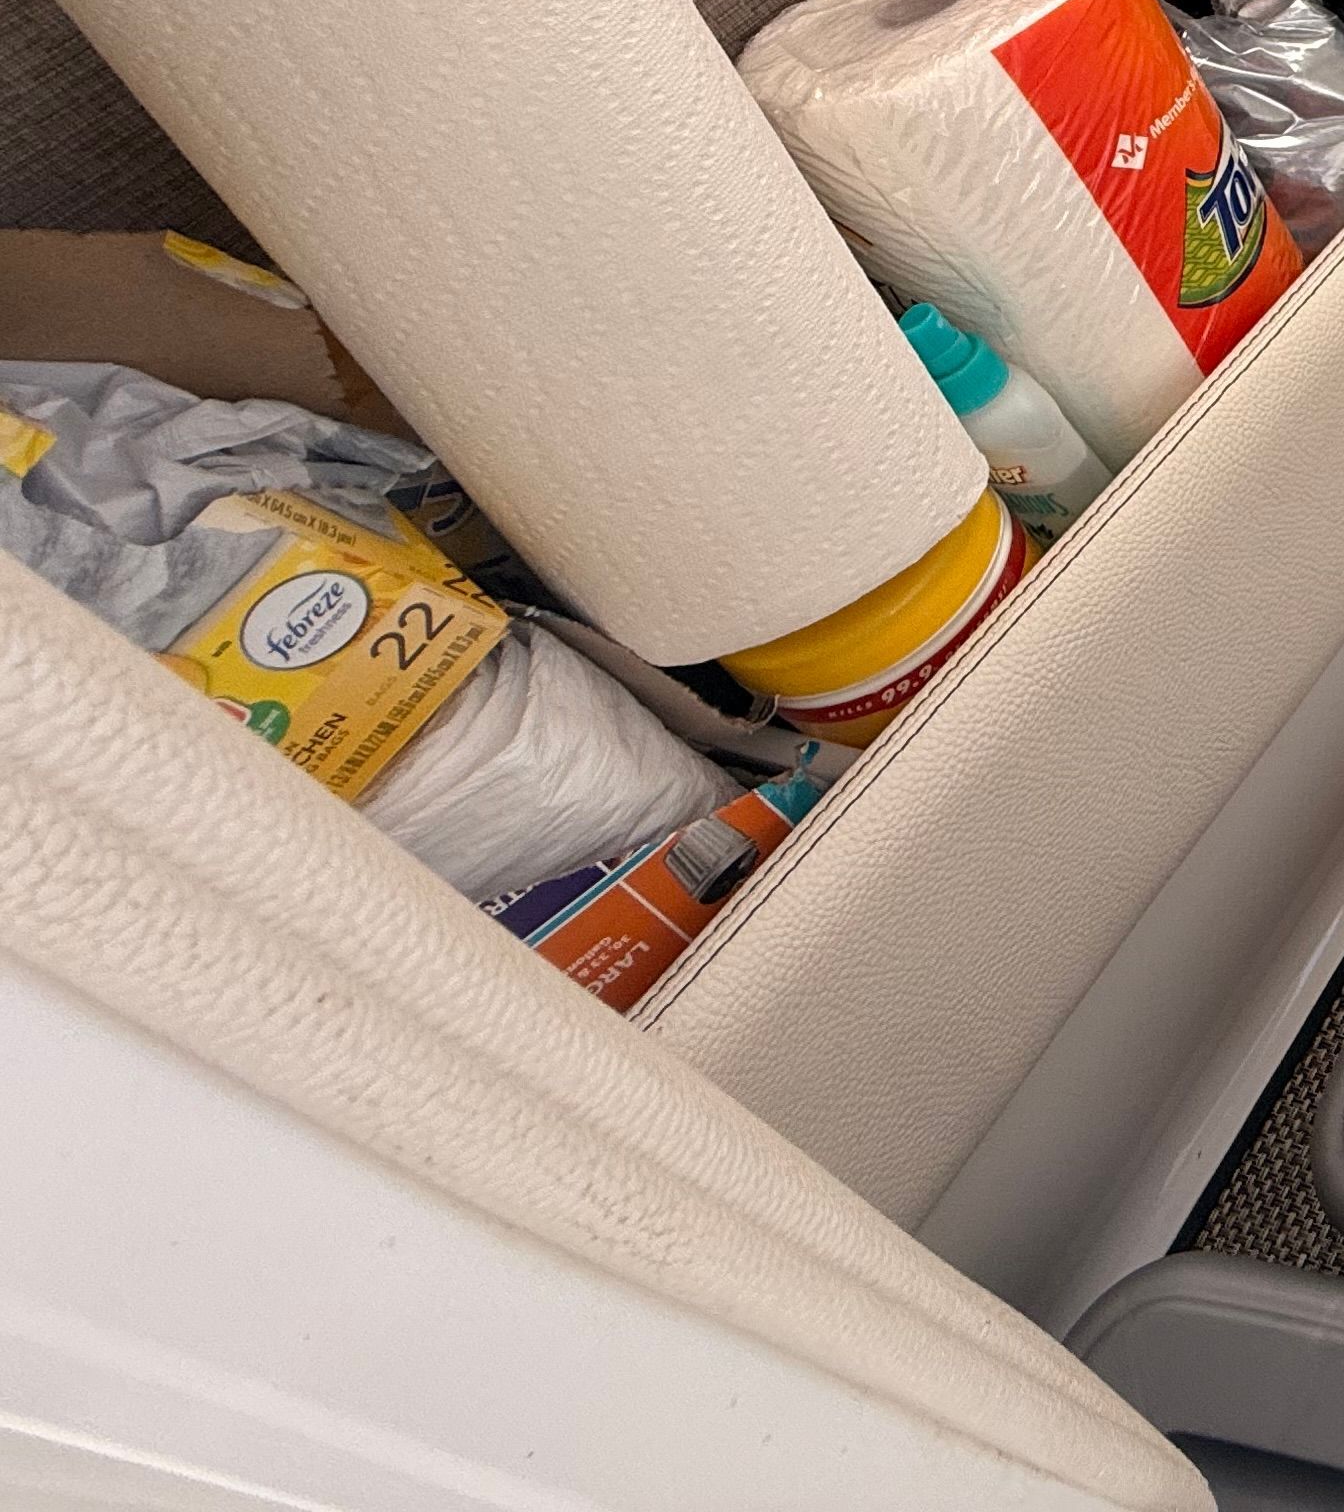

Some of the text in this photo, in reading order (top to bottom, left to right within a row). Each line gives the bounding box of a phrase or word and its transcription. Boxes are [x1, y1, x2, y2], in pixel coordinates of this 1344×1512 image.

[1198, 152, 1257, 263] To
[266, 579, 345, 663] febreze
[298, 601, 353, 654] freshness
[370, 601, 455, 671] 22
